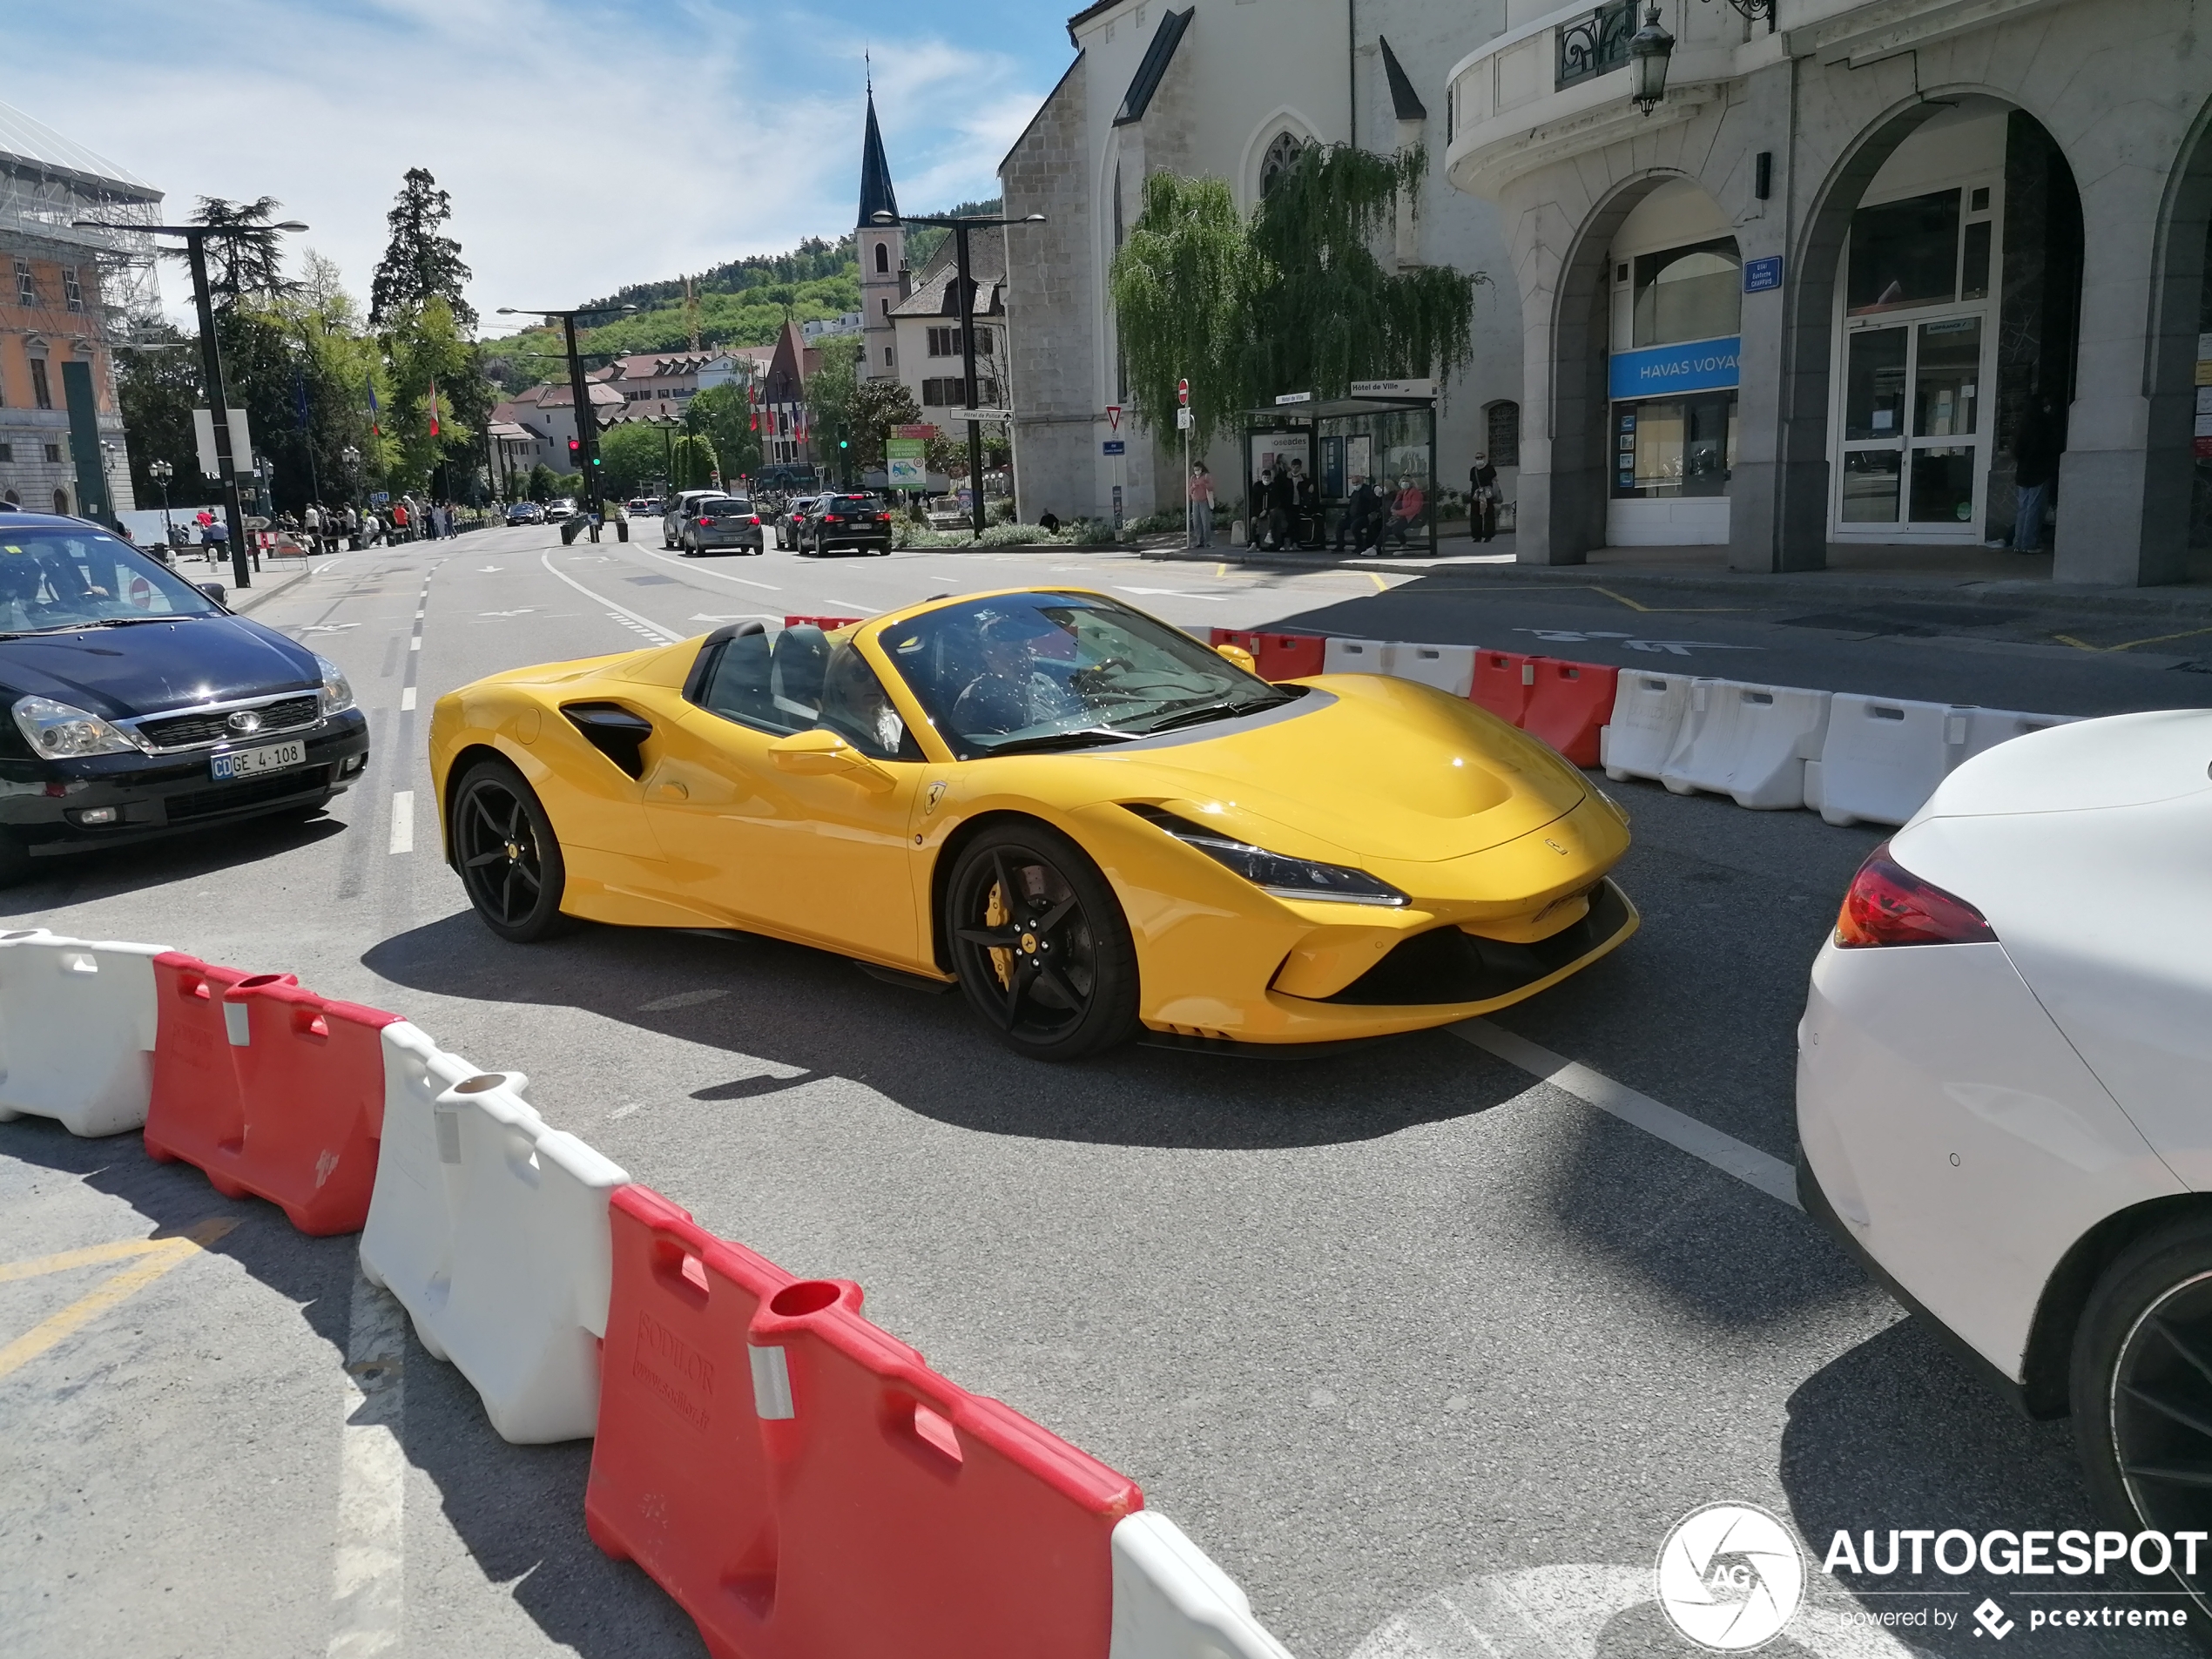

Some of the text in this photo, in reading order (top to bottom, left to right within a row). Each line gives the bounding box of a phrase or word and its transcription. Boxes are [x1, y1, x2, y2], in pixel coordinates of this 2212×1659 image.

[1640, 360, 1689, 380] HAVAS
[214, 759, 232, 777] CD
[233, 754, 251, 772] GE
